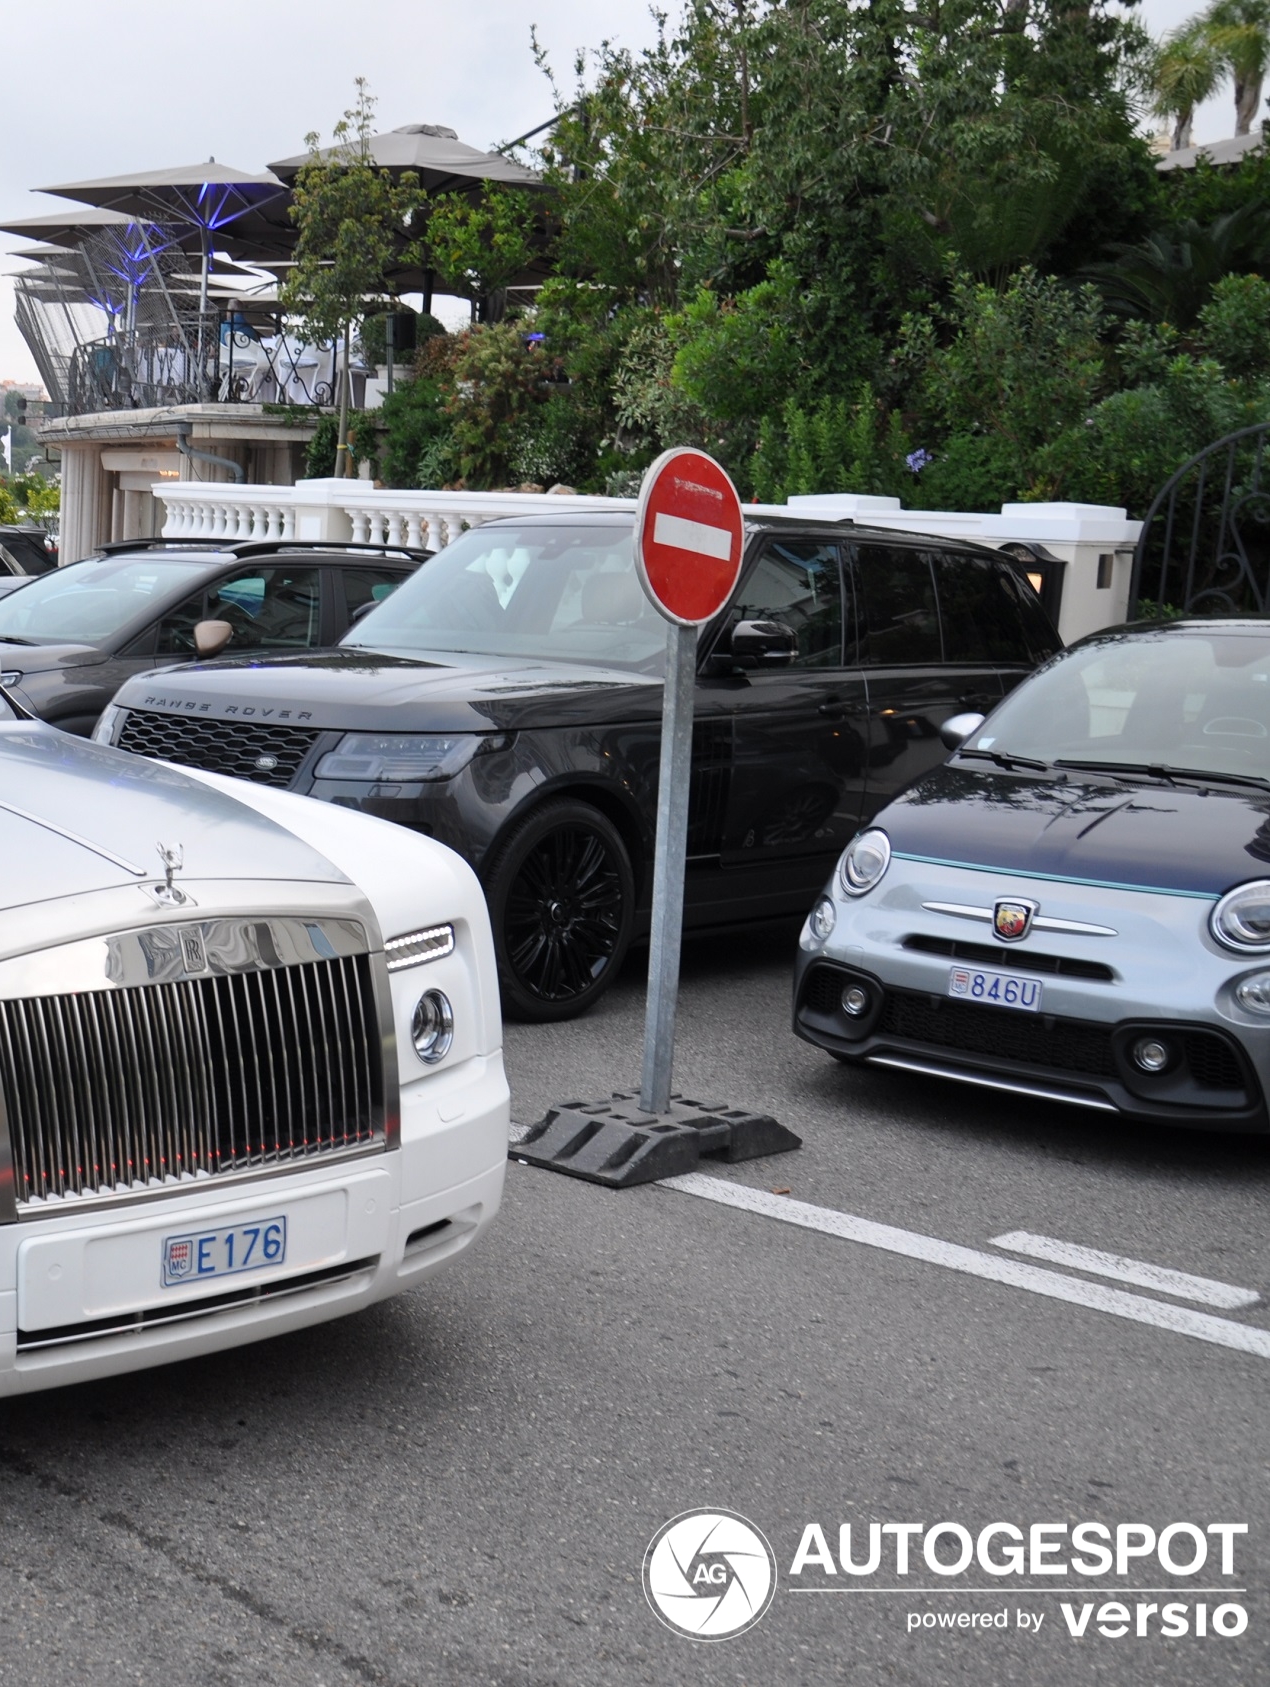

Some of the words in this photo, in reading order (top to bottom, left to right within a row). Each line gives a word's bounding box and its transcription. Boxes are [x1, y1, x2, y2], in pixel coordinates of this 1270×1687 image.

[145, 696, 212, 712] RANGE
[225, 705, 313, 720] ROVER
[971, 974, 1037, 1006] 846U
[197, 1224, 282, 1274] E176
[171, 1259, 187, 1272] MC
